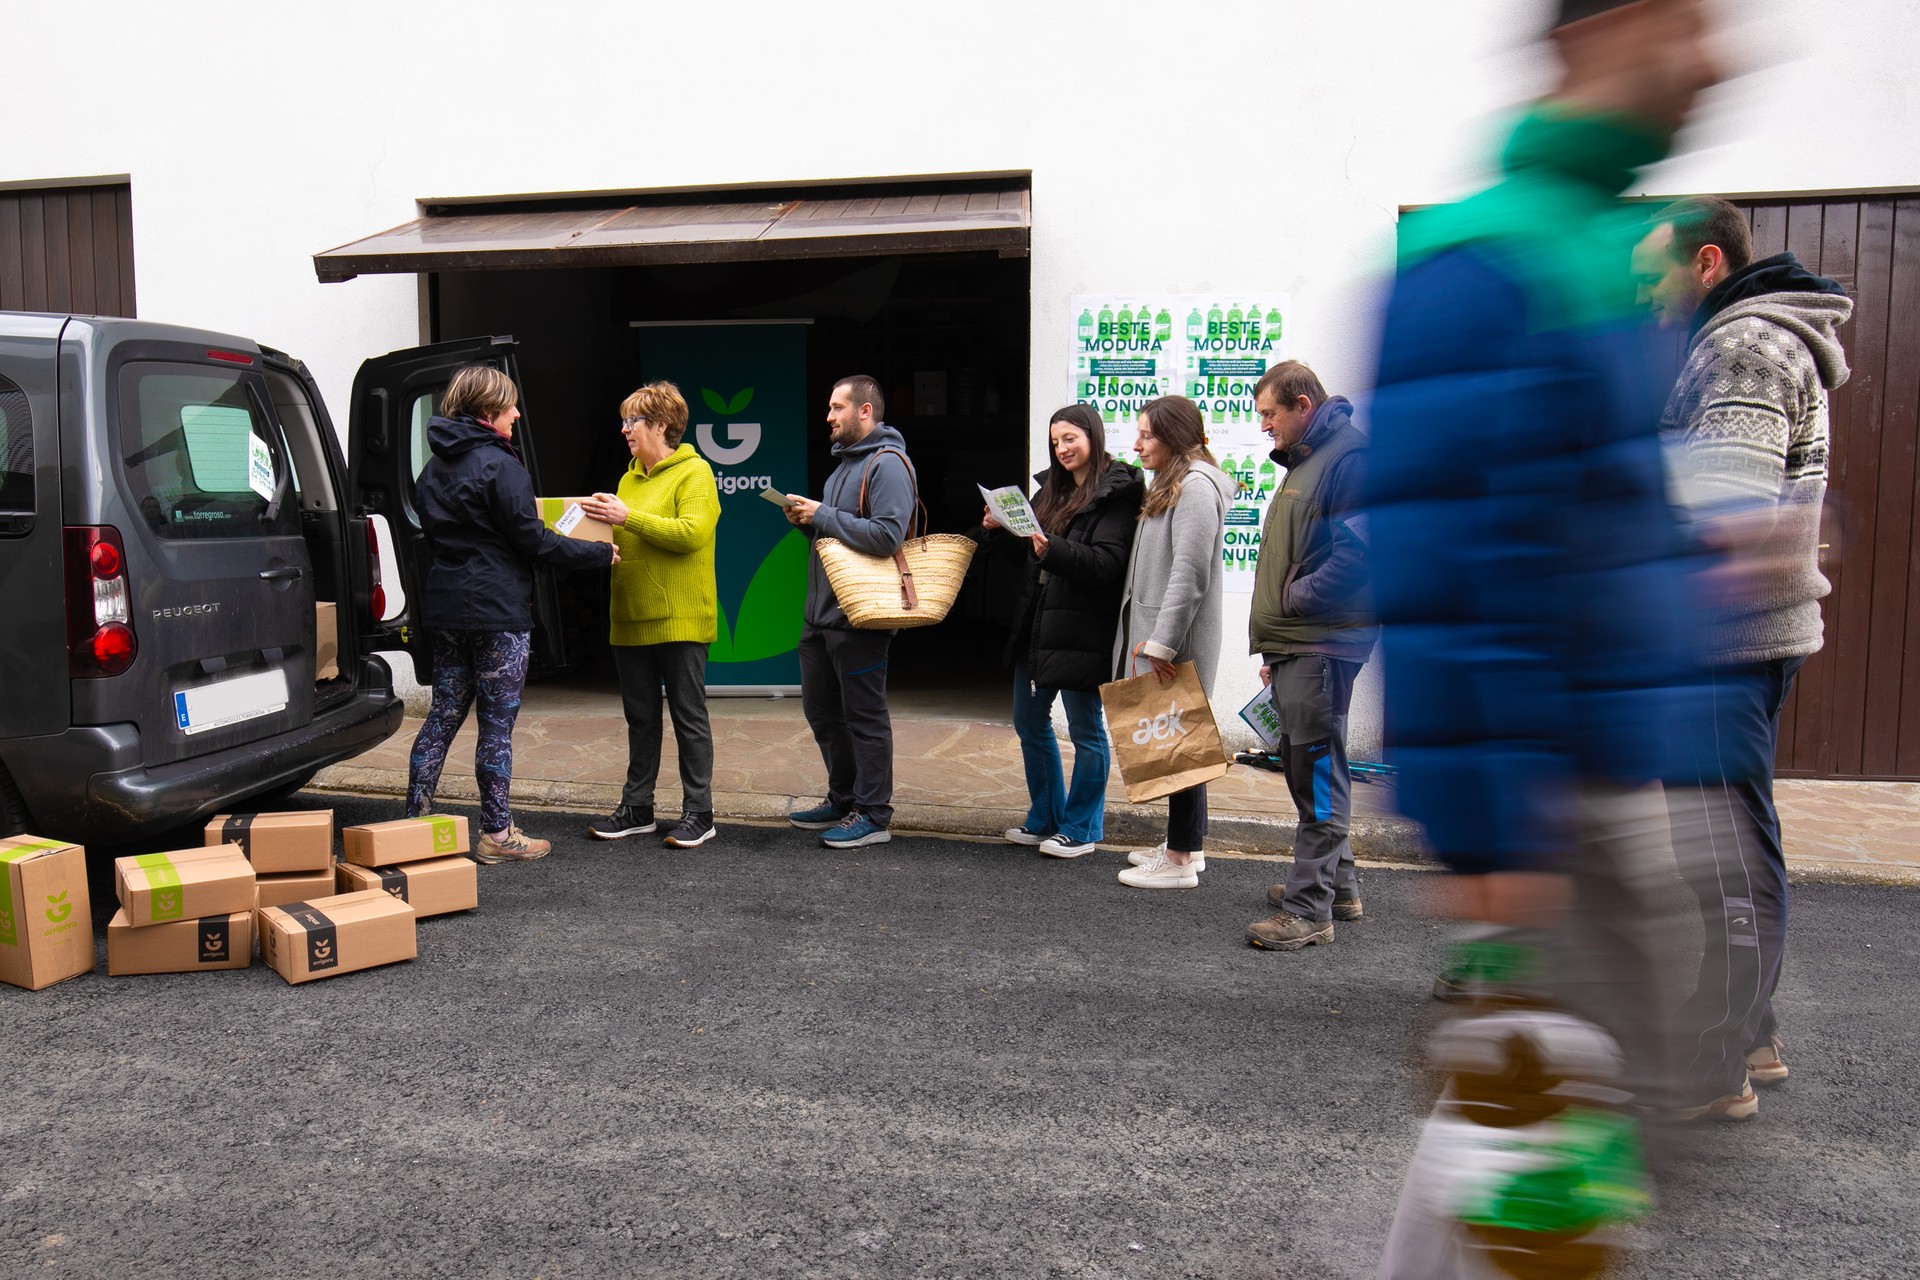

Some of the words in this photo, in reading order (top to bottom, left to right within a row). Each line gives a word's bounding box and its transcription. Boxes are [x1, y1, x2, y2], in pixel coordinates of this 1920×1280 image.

[1099, 321, 1150, 335] BESTE
[1208, 321, 1260, 334] BESTE
[1085, 339, 1163, 351] MODURA
[1194, 338, 1273, 351] MODURA
[1085, 383, 1160, 396] DENONA
[1193, 383, 1256, 396] DENON
[1105, 399, 1151, 412] ONU
[1214, 399, 1258, 412] ONU
[714, 471, 772, 495] igora
[1224, 532, 1262, 545] ONA
[1222, 548, 1259, 561] NUR
[152, 602, 221, 619] PEUGEOT
[181, 713, 187, 722] E
[1132, 699, 1187, 745] aek
